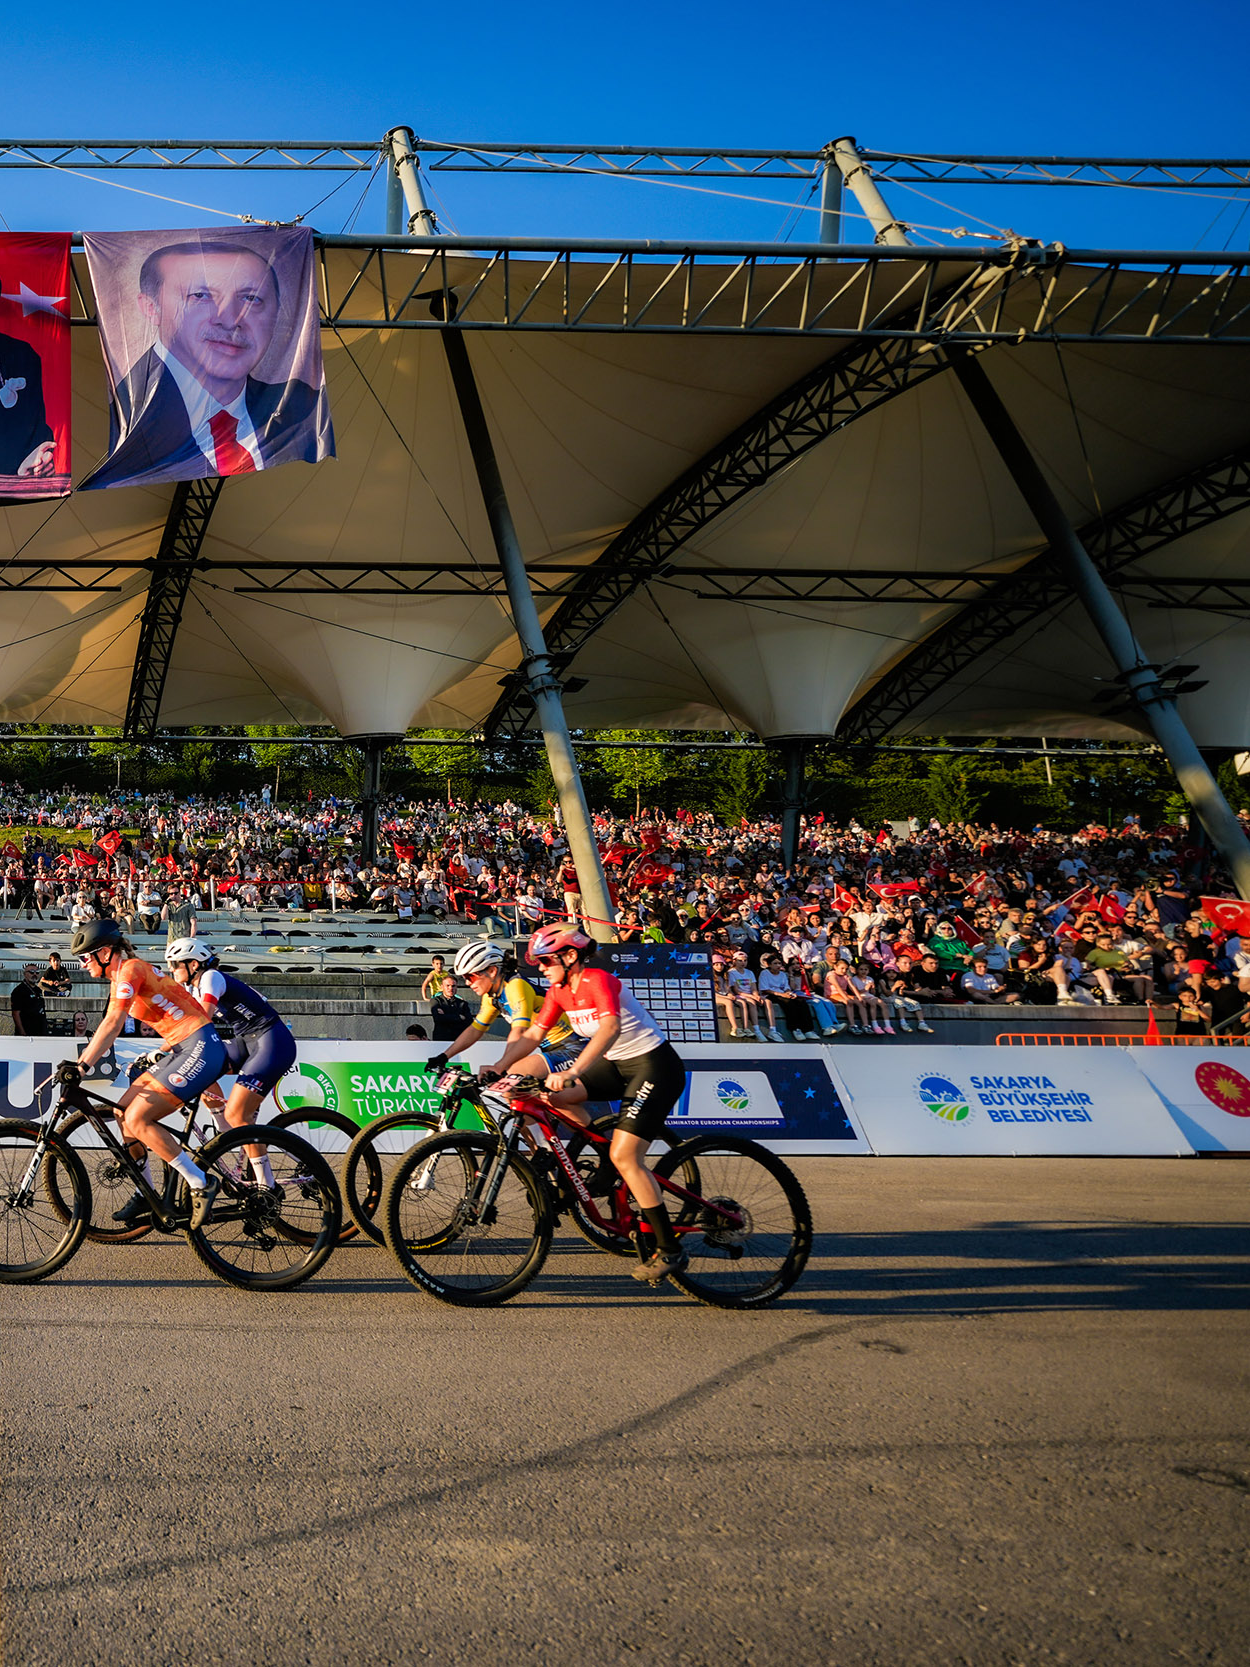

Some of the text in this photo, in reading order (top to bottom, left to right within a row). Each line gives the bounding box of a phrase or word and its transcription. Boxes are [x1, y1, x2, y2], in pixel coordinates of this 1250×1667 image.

[177, 1040, 206, 1075] NEDERLANDSE
[185, 1059, 207, 1080] LOTERIJ
[317, 1074, 334, 1096] BIKE
[351, 1075, 452, 1093] SAKARY
[970, 1076, 1057, 1089] SAKARYA
[977, 1090, 1094, 1109] BÜYÜKŞEHİR
[987, 1107, 1093, 1122] BELEDİYESİ
[550, 1135, 590, 1202] cannondale
